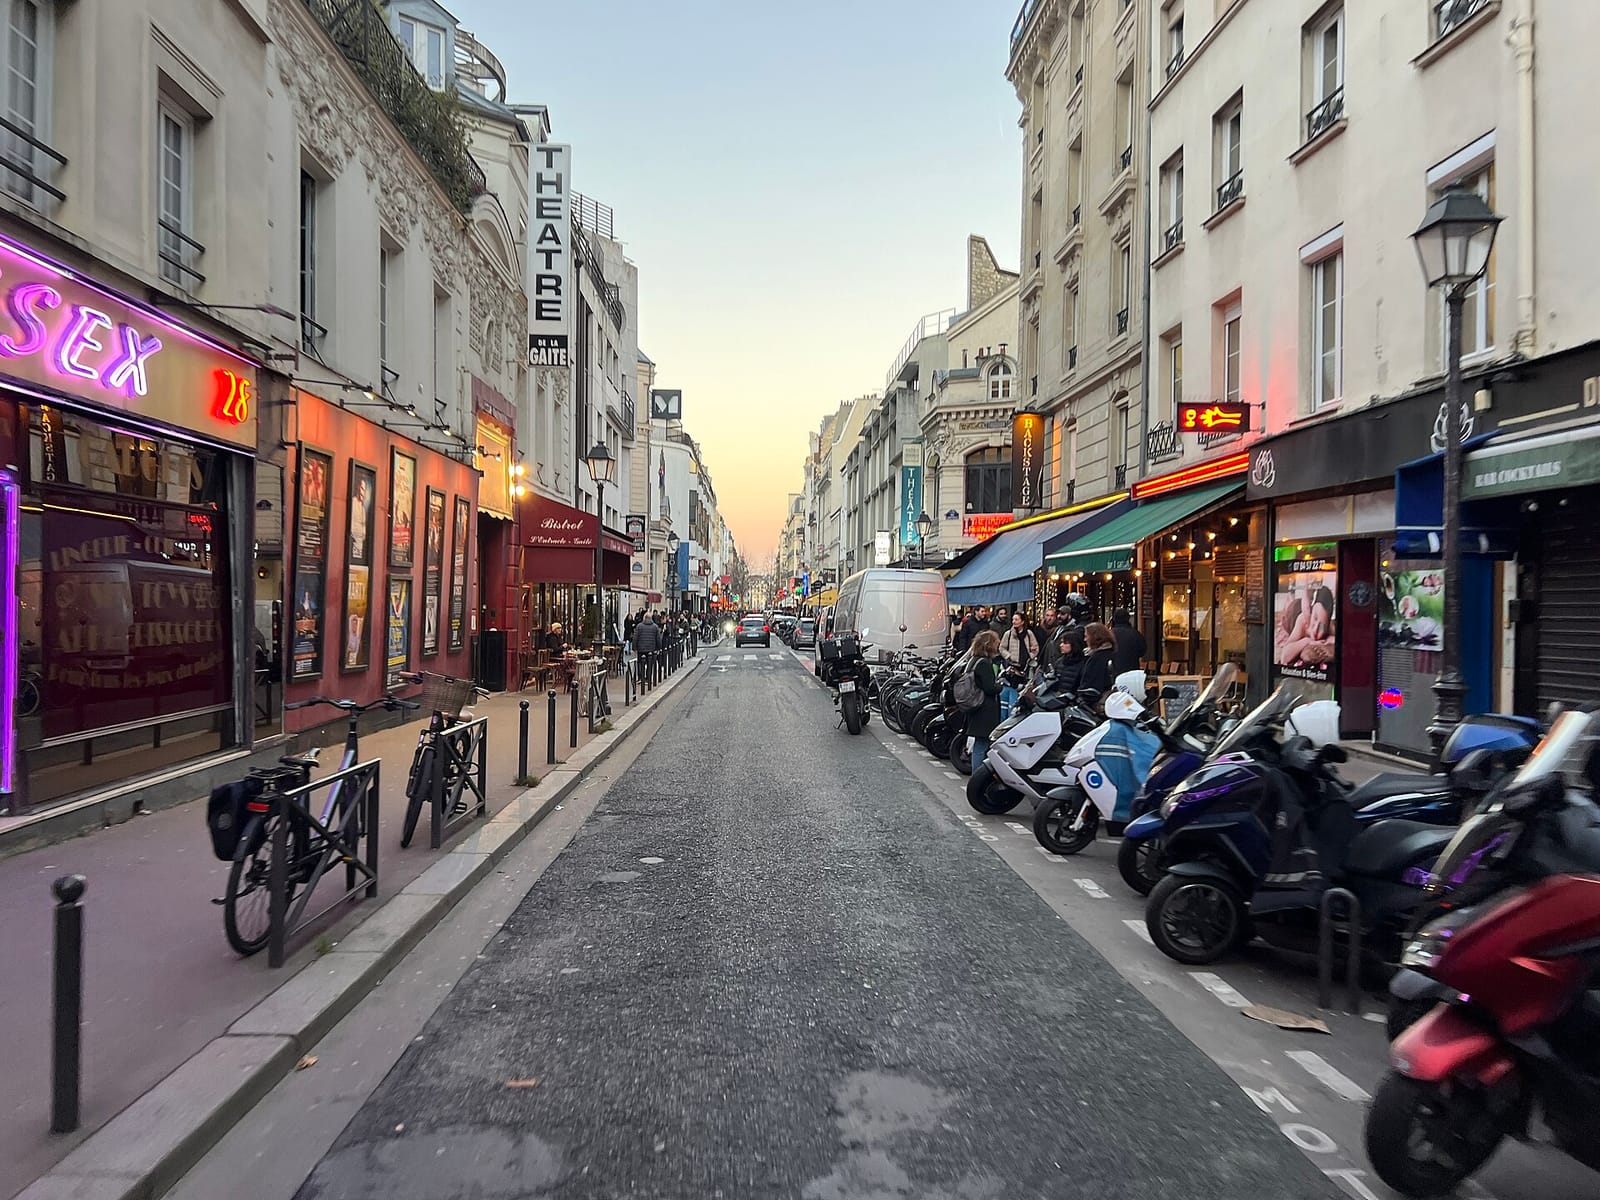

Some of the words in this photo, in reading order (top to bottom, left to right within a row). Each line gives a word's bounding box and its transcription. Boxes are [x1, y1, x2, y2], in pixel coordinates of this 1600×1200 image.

[536, 146, 563, 321] THEATRE
[0, 282, 163, 397] SEX
[529, 347, 567, 365] GAITE
[537, 338, 547, 347] DE
[550, 338, 559, 347] LA
[1021, 418, 1034, 506] BACKSTAGE
[540, 517, 584, 530] Bistrot
